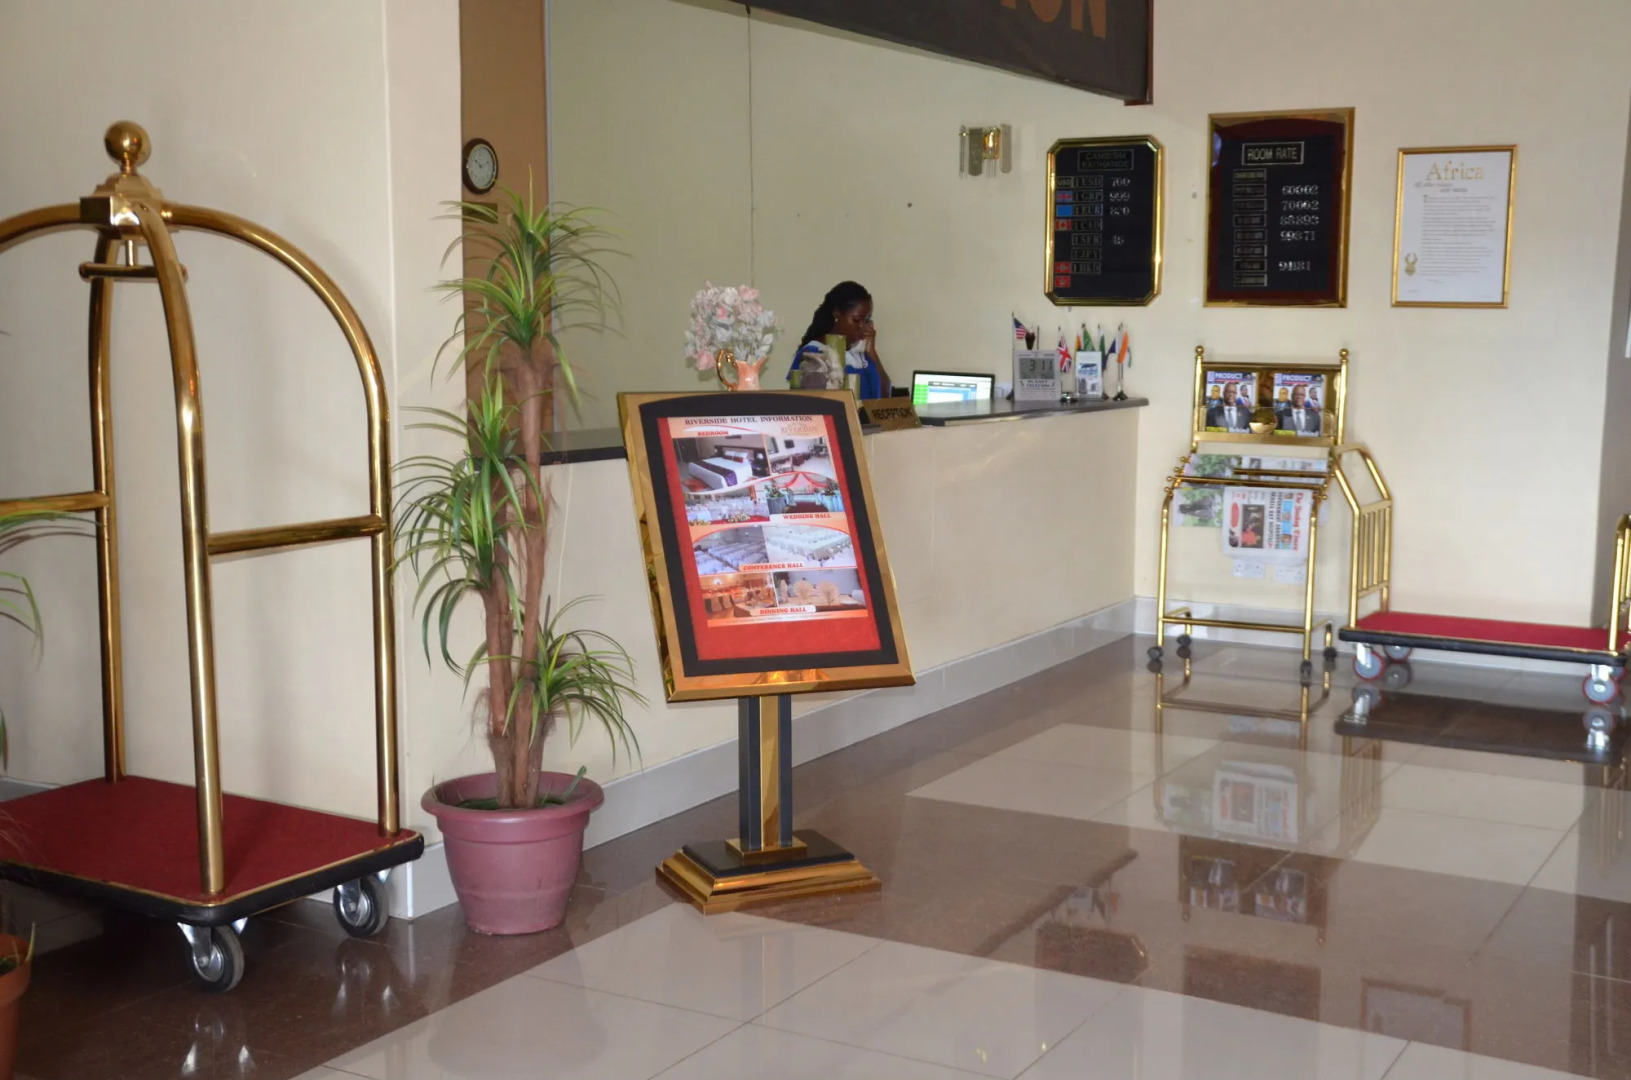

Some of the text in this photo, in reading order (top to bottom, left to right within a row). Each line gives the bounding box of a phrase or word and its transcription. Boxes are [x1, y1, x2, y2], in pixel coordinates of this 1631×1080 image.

[1247, 147, 1298, 161] ROOM RATE
[1425, 160, 1485, 181] Africa
[684, 418, 728, 426] RIVERSIDE
[760, 415, 813, 423] INFORMATION
